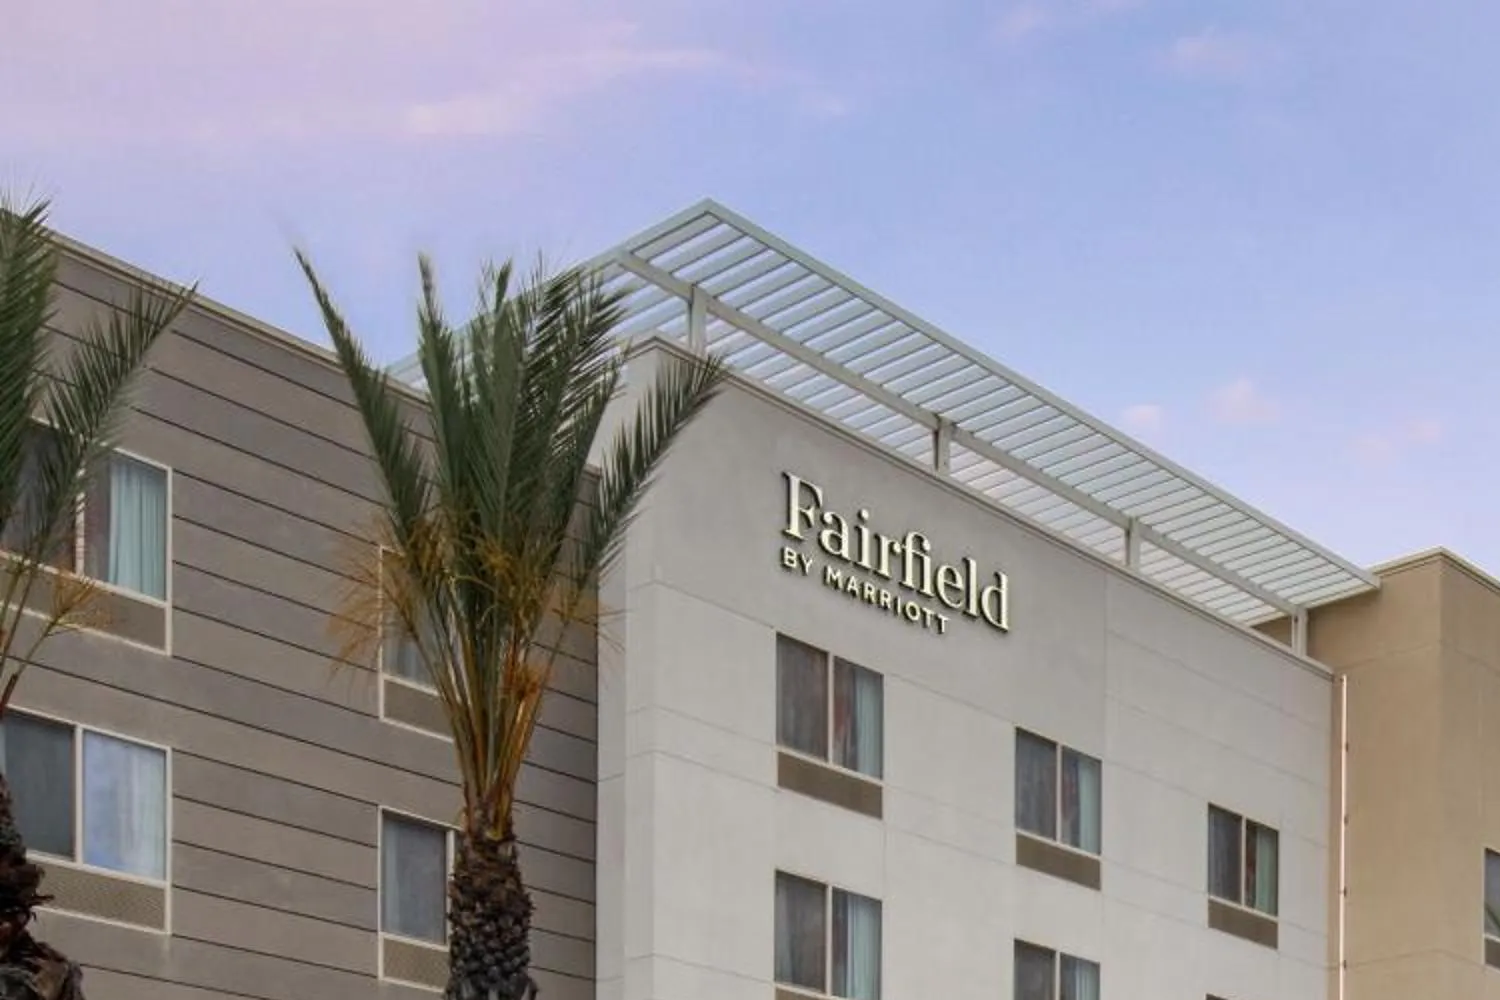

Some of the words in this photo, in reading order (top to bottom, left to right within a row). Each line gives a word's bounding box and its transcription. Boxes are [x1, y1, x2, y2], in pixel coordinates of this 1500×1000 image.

[781, 471, 1010, 630] Fairfield
[782, 546, 813, 575] BY
[825, 564, 949, 634] MARRIOTT
